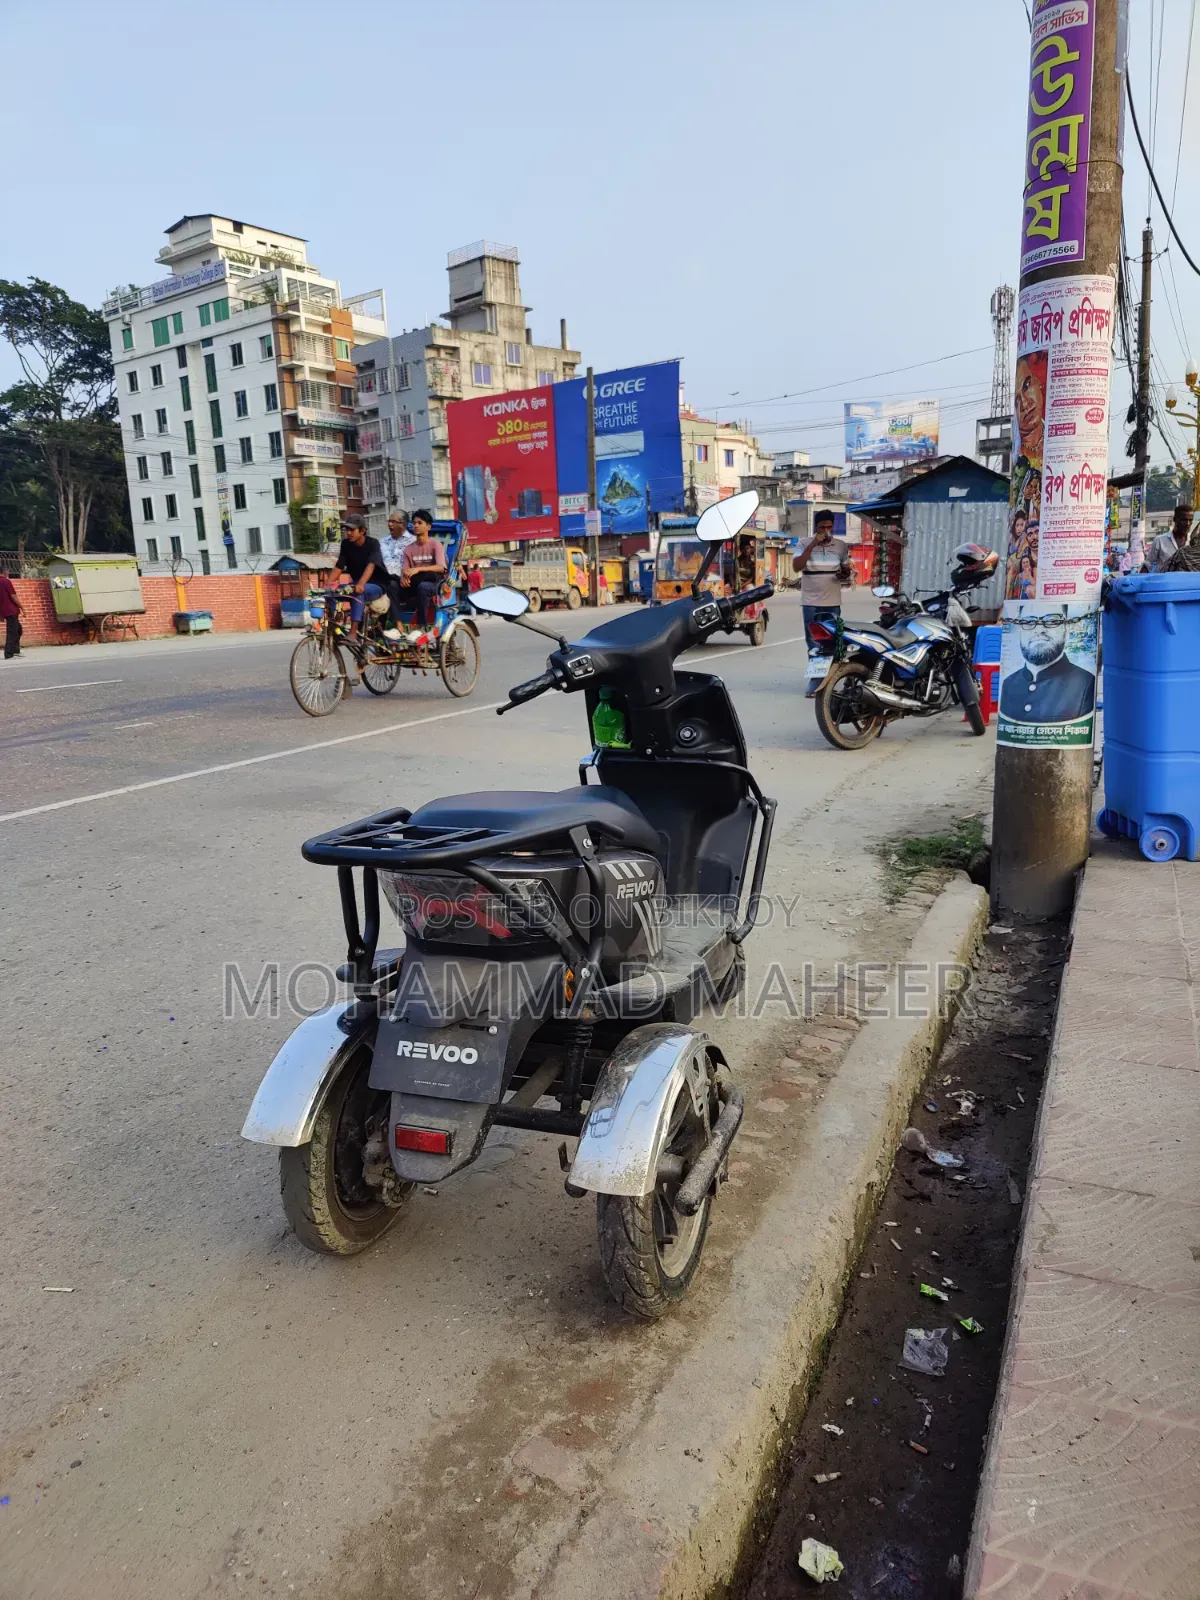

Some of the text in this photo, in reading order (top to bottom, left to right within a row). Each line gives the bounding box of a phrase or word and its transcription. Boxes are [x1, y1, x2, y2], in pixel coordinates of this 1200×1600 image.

[1050, 8, 1085, 31] সার্ভিস
[1031, 302, 1064, 345] জরিপ
[1068, 297, 1111, 341] প্রশিক্ষণ
[600, 377, 647, 398] GREE
[483, 399, 528, 417] KONKA
[497, 418, 523, 436] ১৪০
[604, 414, 638, 428] FUTURE
[889, 415, 913, 426] Cool
[889, 425, 913, 435] Care
[1036, 726, 1063, 735] হোসেন
[1064, 724, 1089, 735] শিকদার
[617, 880, 655, 900] REVOO
[396, 1040, 479, 1065] REVOO
